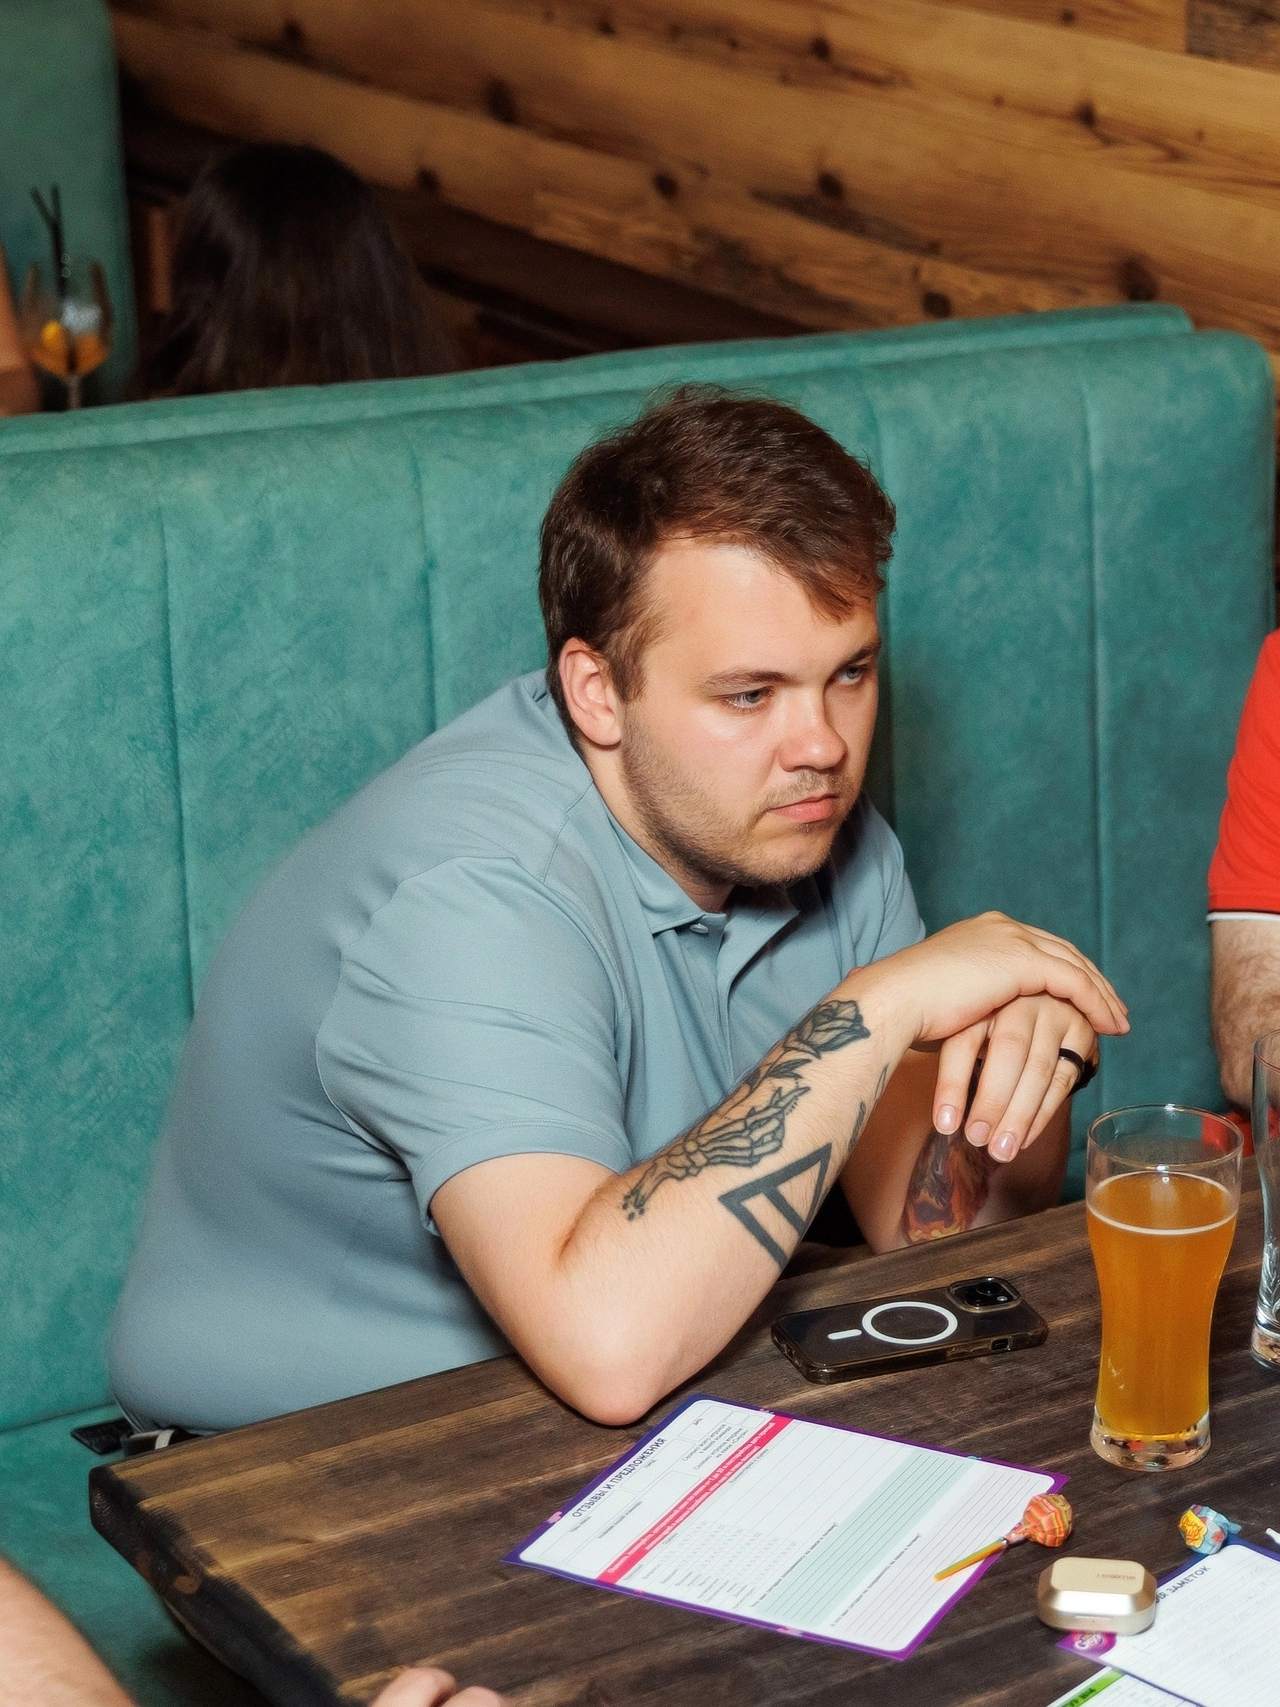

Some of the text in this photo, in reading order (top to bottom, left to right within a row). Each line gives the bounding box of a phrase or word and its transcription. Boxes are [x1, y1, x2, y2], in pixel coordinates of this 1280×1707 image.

[572, 1490, 608, 1517] ОТЗЫВЫ
[611, 1438, 667, 1484] ПРЕДЛОЖЕНИЯ
[1166, 1565, 1211, 1593] ЗАМЕТОК
